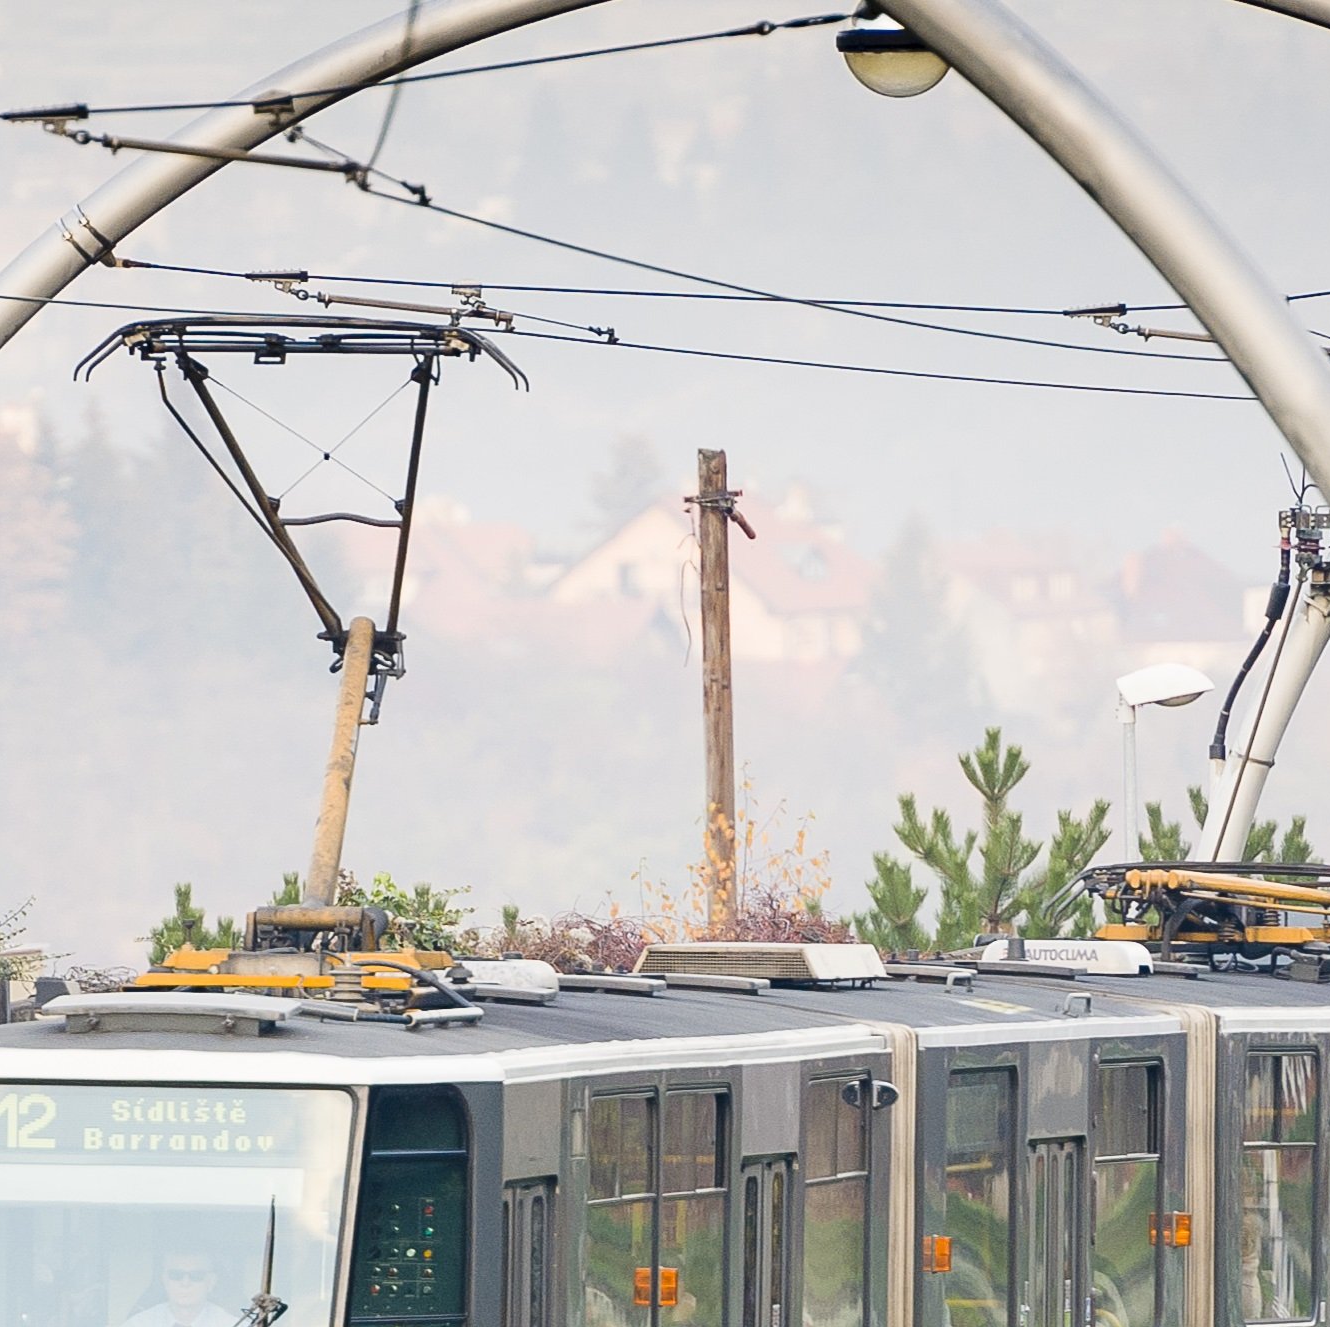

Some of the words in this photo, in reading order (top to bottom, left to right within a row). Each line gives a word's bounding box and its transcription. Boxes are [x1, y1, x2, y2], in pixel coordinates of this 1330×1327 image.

[1026, 949, 1098, 961] AUTOCLIMA
[112, 1098, 247, 1123] Sídliště
[83, 1127, 273, 1151] Barrandov
